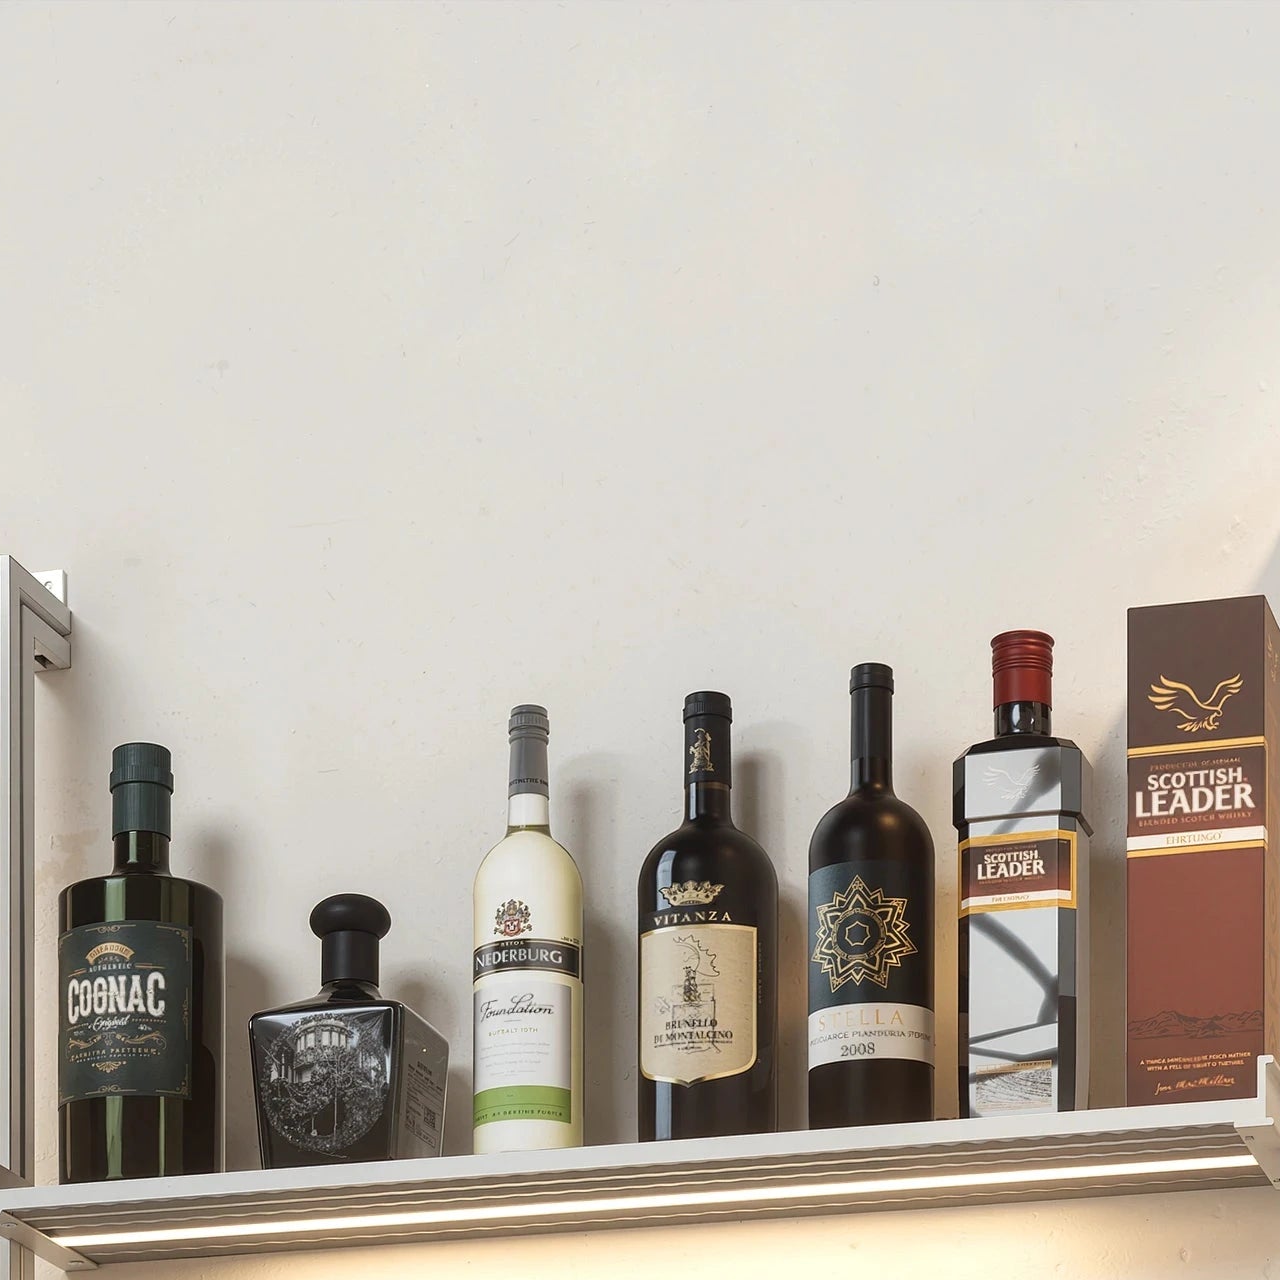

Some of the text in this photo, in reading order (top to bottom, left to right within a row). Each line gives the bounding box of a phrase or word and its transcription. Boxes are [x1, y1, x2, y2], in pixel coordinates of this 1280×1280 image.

[1147, 766, 1243, 792] SCOTTISH
[1135, 782, 1256, 819] LEADER
[983, 849, 1039, 866] SCOTTISH
[977, 859, 1046, 881] LEADER
[653, 910, 733, 927] VITANZA
[475, 948, 564, 971] NEDERBURG
[67, 971, 166, 1025] COGNAC
[818, 1007, 904, 1033] STELLA
[665, 1030, 733, 1043] MONTALCINO
[840, 1041, 876, 1058] 2008
